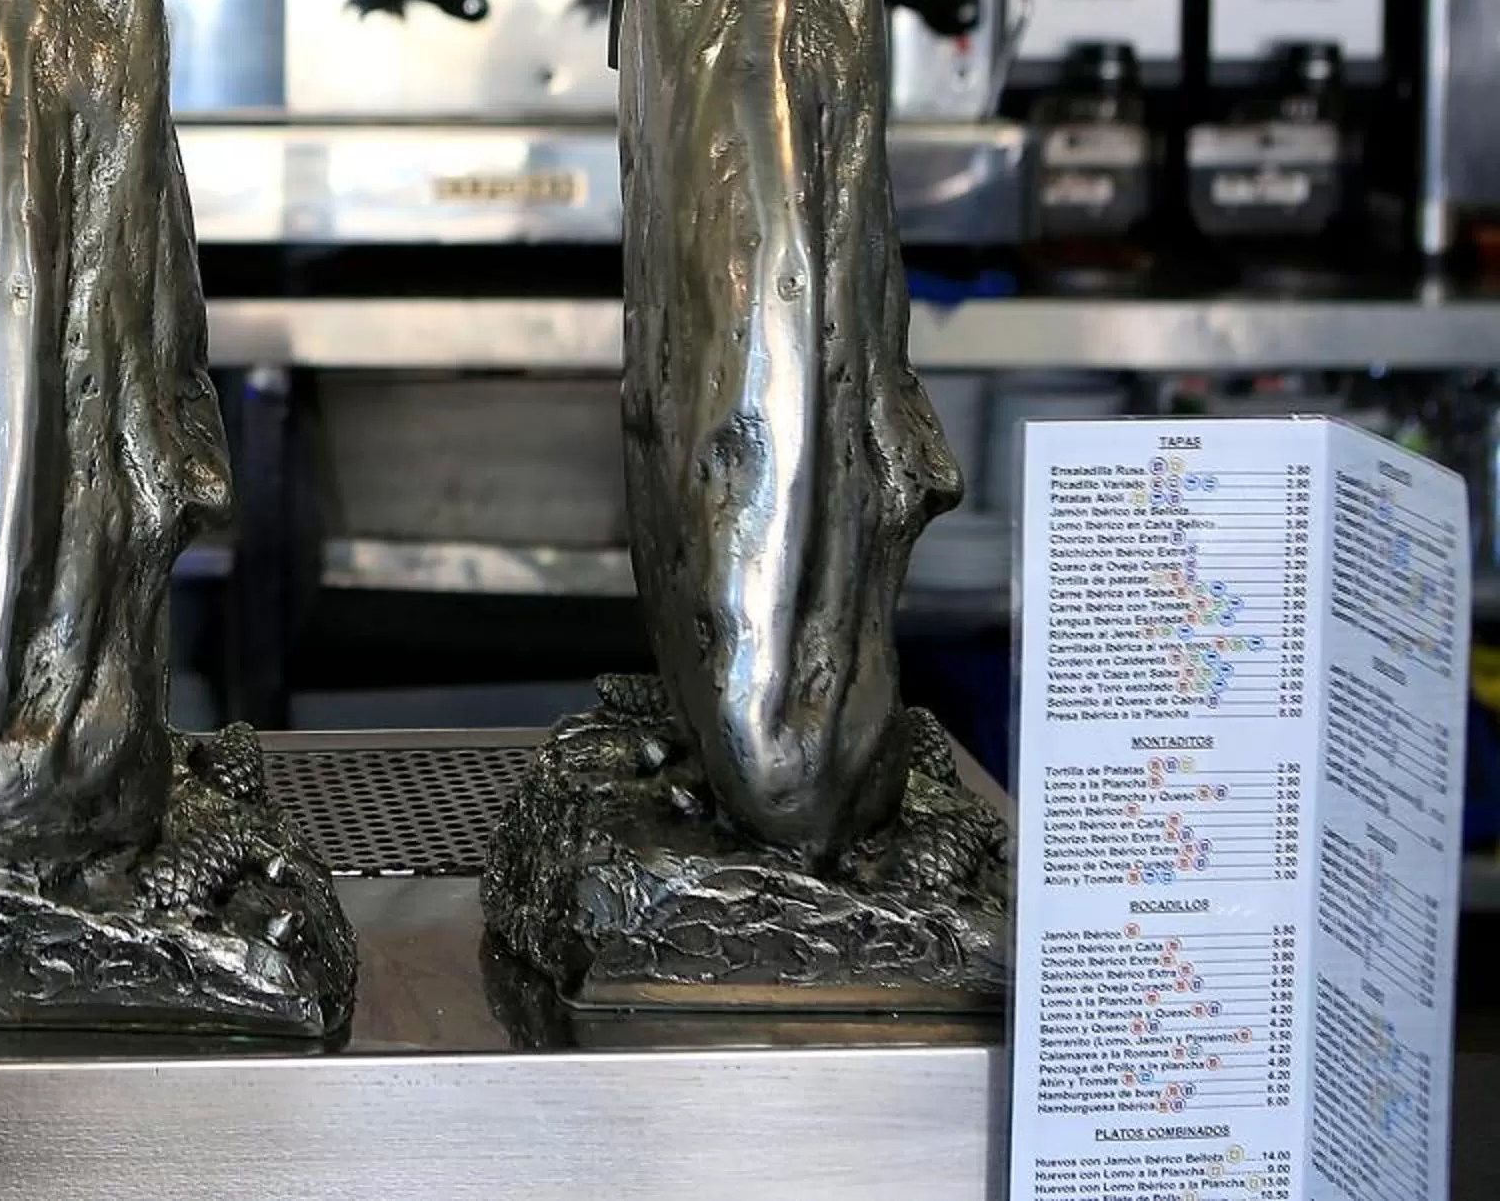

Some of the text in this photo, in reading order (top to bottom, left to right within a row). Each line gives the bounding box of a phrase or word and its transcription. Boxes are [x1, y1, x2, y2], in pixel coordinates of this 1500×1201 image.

[1158, 437, 1202, 449] TAPAS
[1131, 735, 1214, 749] MONTADITOS
[1045, 765, 1144, 775] Tortilla de Patatas
[1044, 794, 1076, 804] Lomo
[1090, 793, 1099, 802] la
[1102, 792, 1146, 802] Plancha
[1159, 791, 1196, 801] Queso
[1084, 874, 1123, 883] Tomate
[1130, 899, 1210, 913] BOCADILLOS
[1040, 998, 1072, 1007] Lomo
[1086, 997, 1095, 1007] la
[1098, 997, 1143, 1007] Plancha
[1092, 1023, 1128, 1033] Queso
[1040, 1051, 1098, 1061] Calamares
[1111, 1050, 1120, 1059] la
[1123, 1049, 1168, 1059] Romana
[1091, 1063, 1104, 1073] de
[1079, 1077, 1118, 1086] Tomate
[1038, 1090, 1114, 1101] Hamburguesa
[1118, 1090, 1132, 1099] de
[1038, 1103, 1114, 1114] Hamburguesa
[1096, 1125, 1230, 1141] PLATOS COMBINADOS
[1035, 1158, 1076, 1167] Huevos
[1080, 1158, 1100, 1167] con
[1104, 1155, 1141, 1165] Jamón
[1145, 1155, 1182, 1165] Ibérico
[1186, 1153, 1224, 1163] Bellota
[1035, 1171, 1076, 1181] Huevos
[1080, 1171, 1100, 1179] con
[1103, 1169, 1135, 1179] Lomo
[1148, 1167, 1158, 1177] la
[1162, 1167, 1204, 1177] Plancha
[1035, 1185, 1076, 1194] Huevos
[1080, 1185, 1100, 1193] con
[1103, 1182, 1135, 1192] Lomo
[1138, 1181, 1176, 1191] Ibérico
[1188, 1180, 1198, 1189] la
[1202, 1179, 1245, 1189] Plancha
